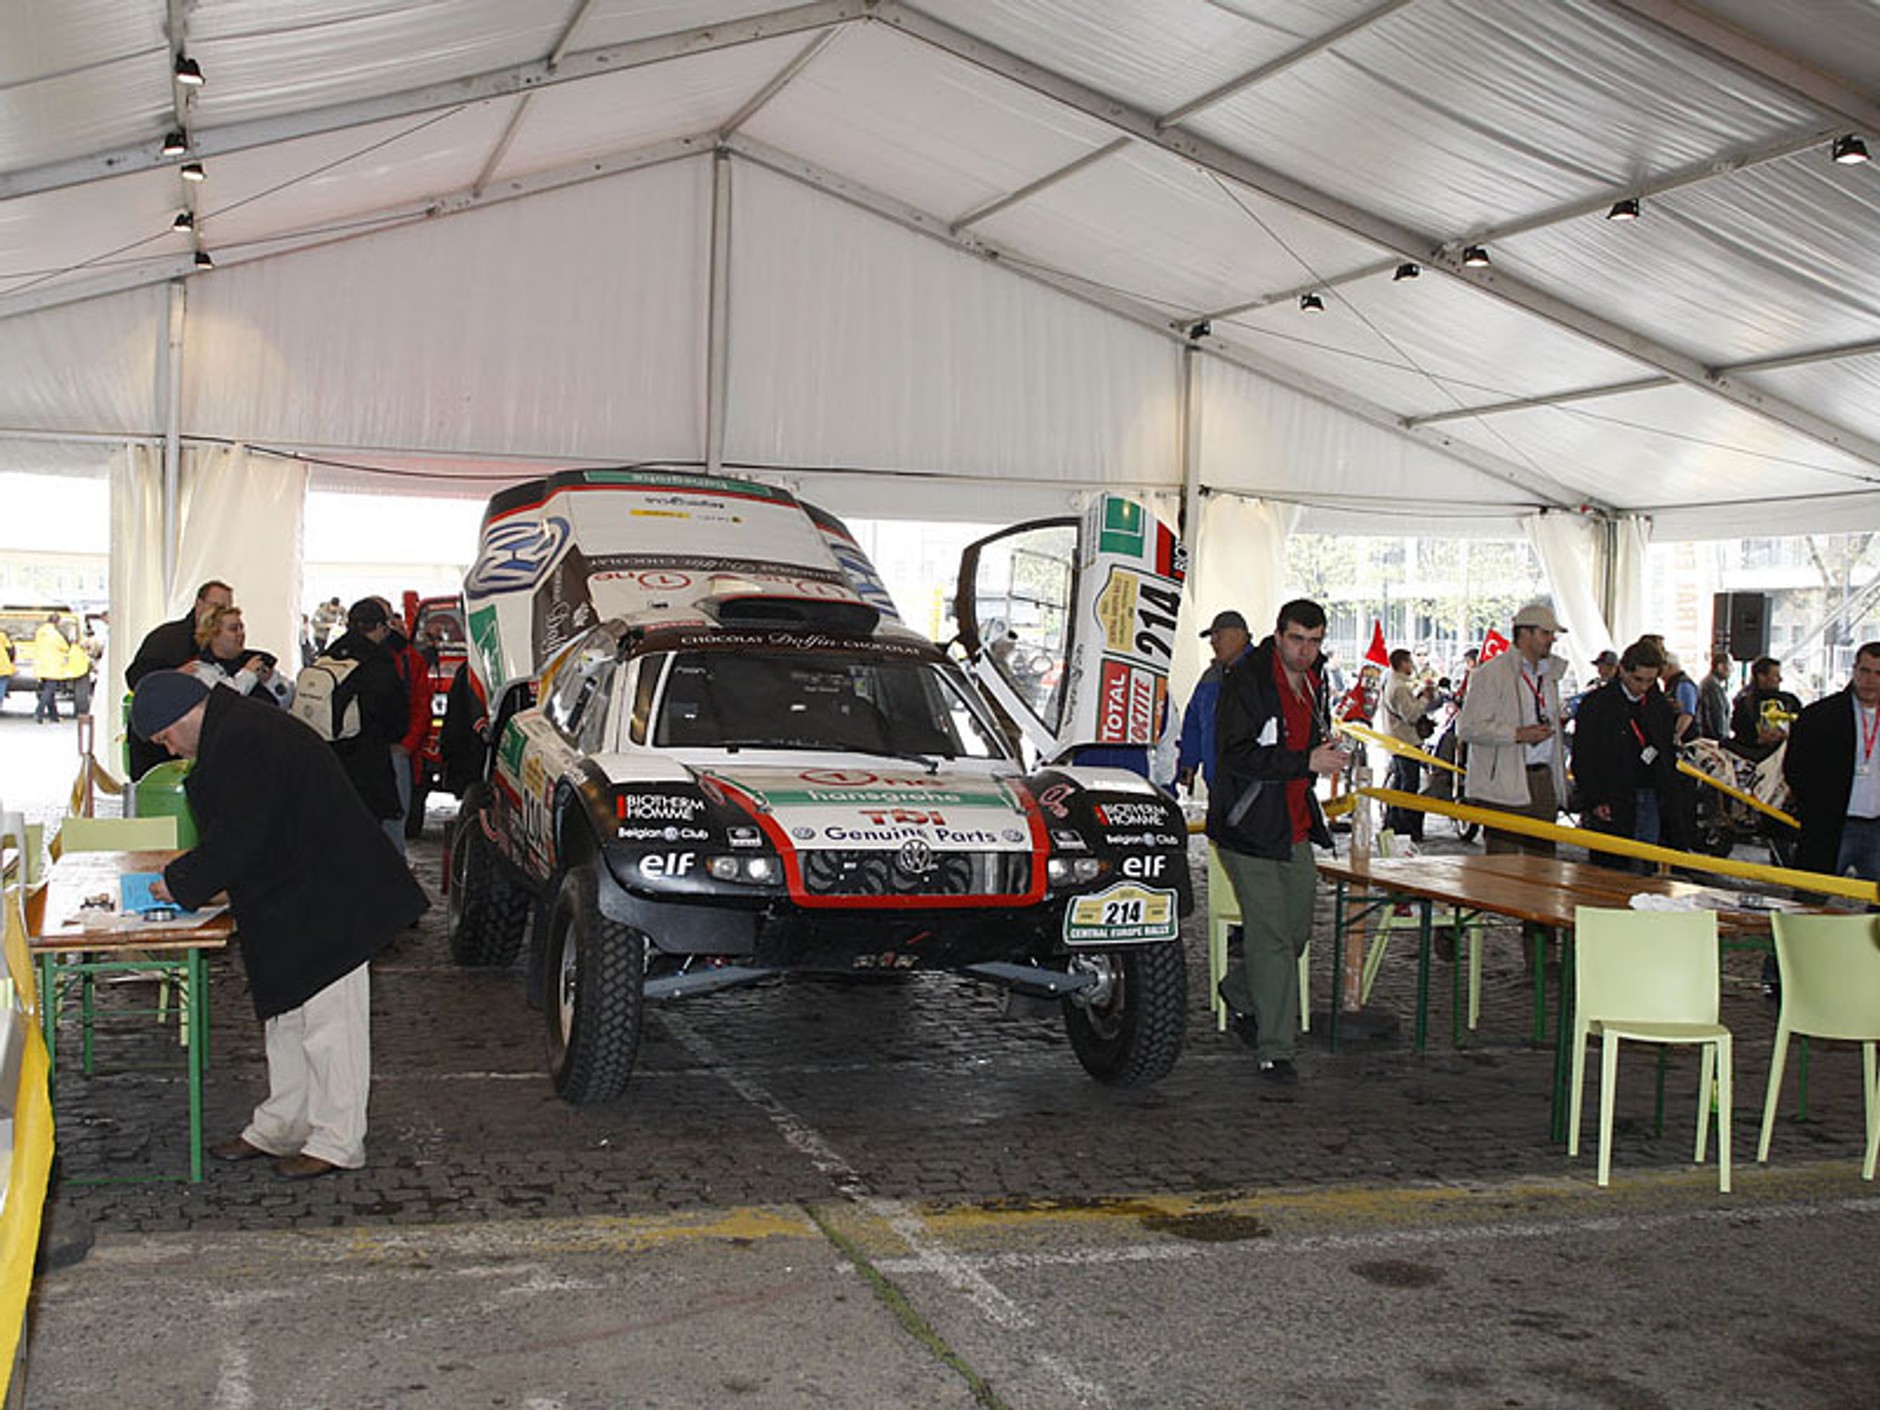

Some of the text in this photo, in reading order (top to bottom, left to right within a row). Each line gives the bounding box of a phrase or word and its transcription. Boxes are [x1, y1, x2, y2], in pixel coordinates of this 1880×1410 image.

[1135, 583, 1181, 659] 214
[680, 635, 764, 646] CHOCOLAT
[842, 641, 921, 655] CHOCOLAT
[1102, 673, 1126, 740] TOTAL
[1130, 677, 1151, 745] OCTITE
[626, 794, 706, 810] BIOTHERM
[807, 789, 961, 803] hansgrohe
[626, 805, 695, 821] HOMME
[858, 808, 947, 826] TDI
[617, 827, 710, 841] Belgian Club
[824, 826, 998, 844] Genuine Parts
[1155, 834, 1179, 846] Club
[638, 852, 695, 880] elf
[1123, 855, 1167, 878] elf
[1104, 900, 1141, 925] 214
[1071, 927, 1108, 939] CENTRAL
[1111, 926, 1143, 937] EUROPE
